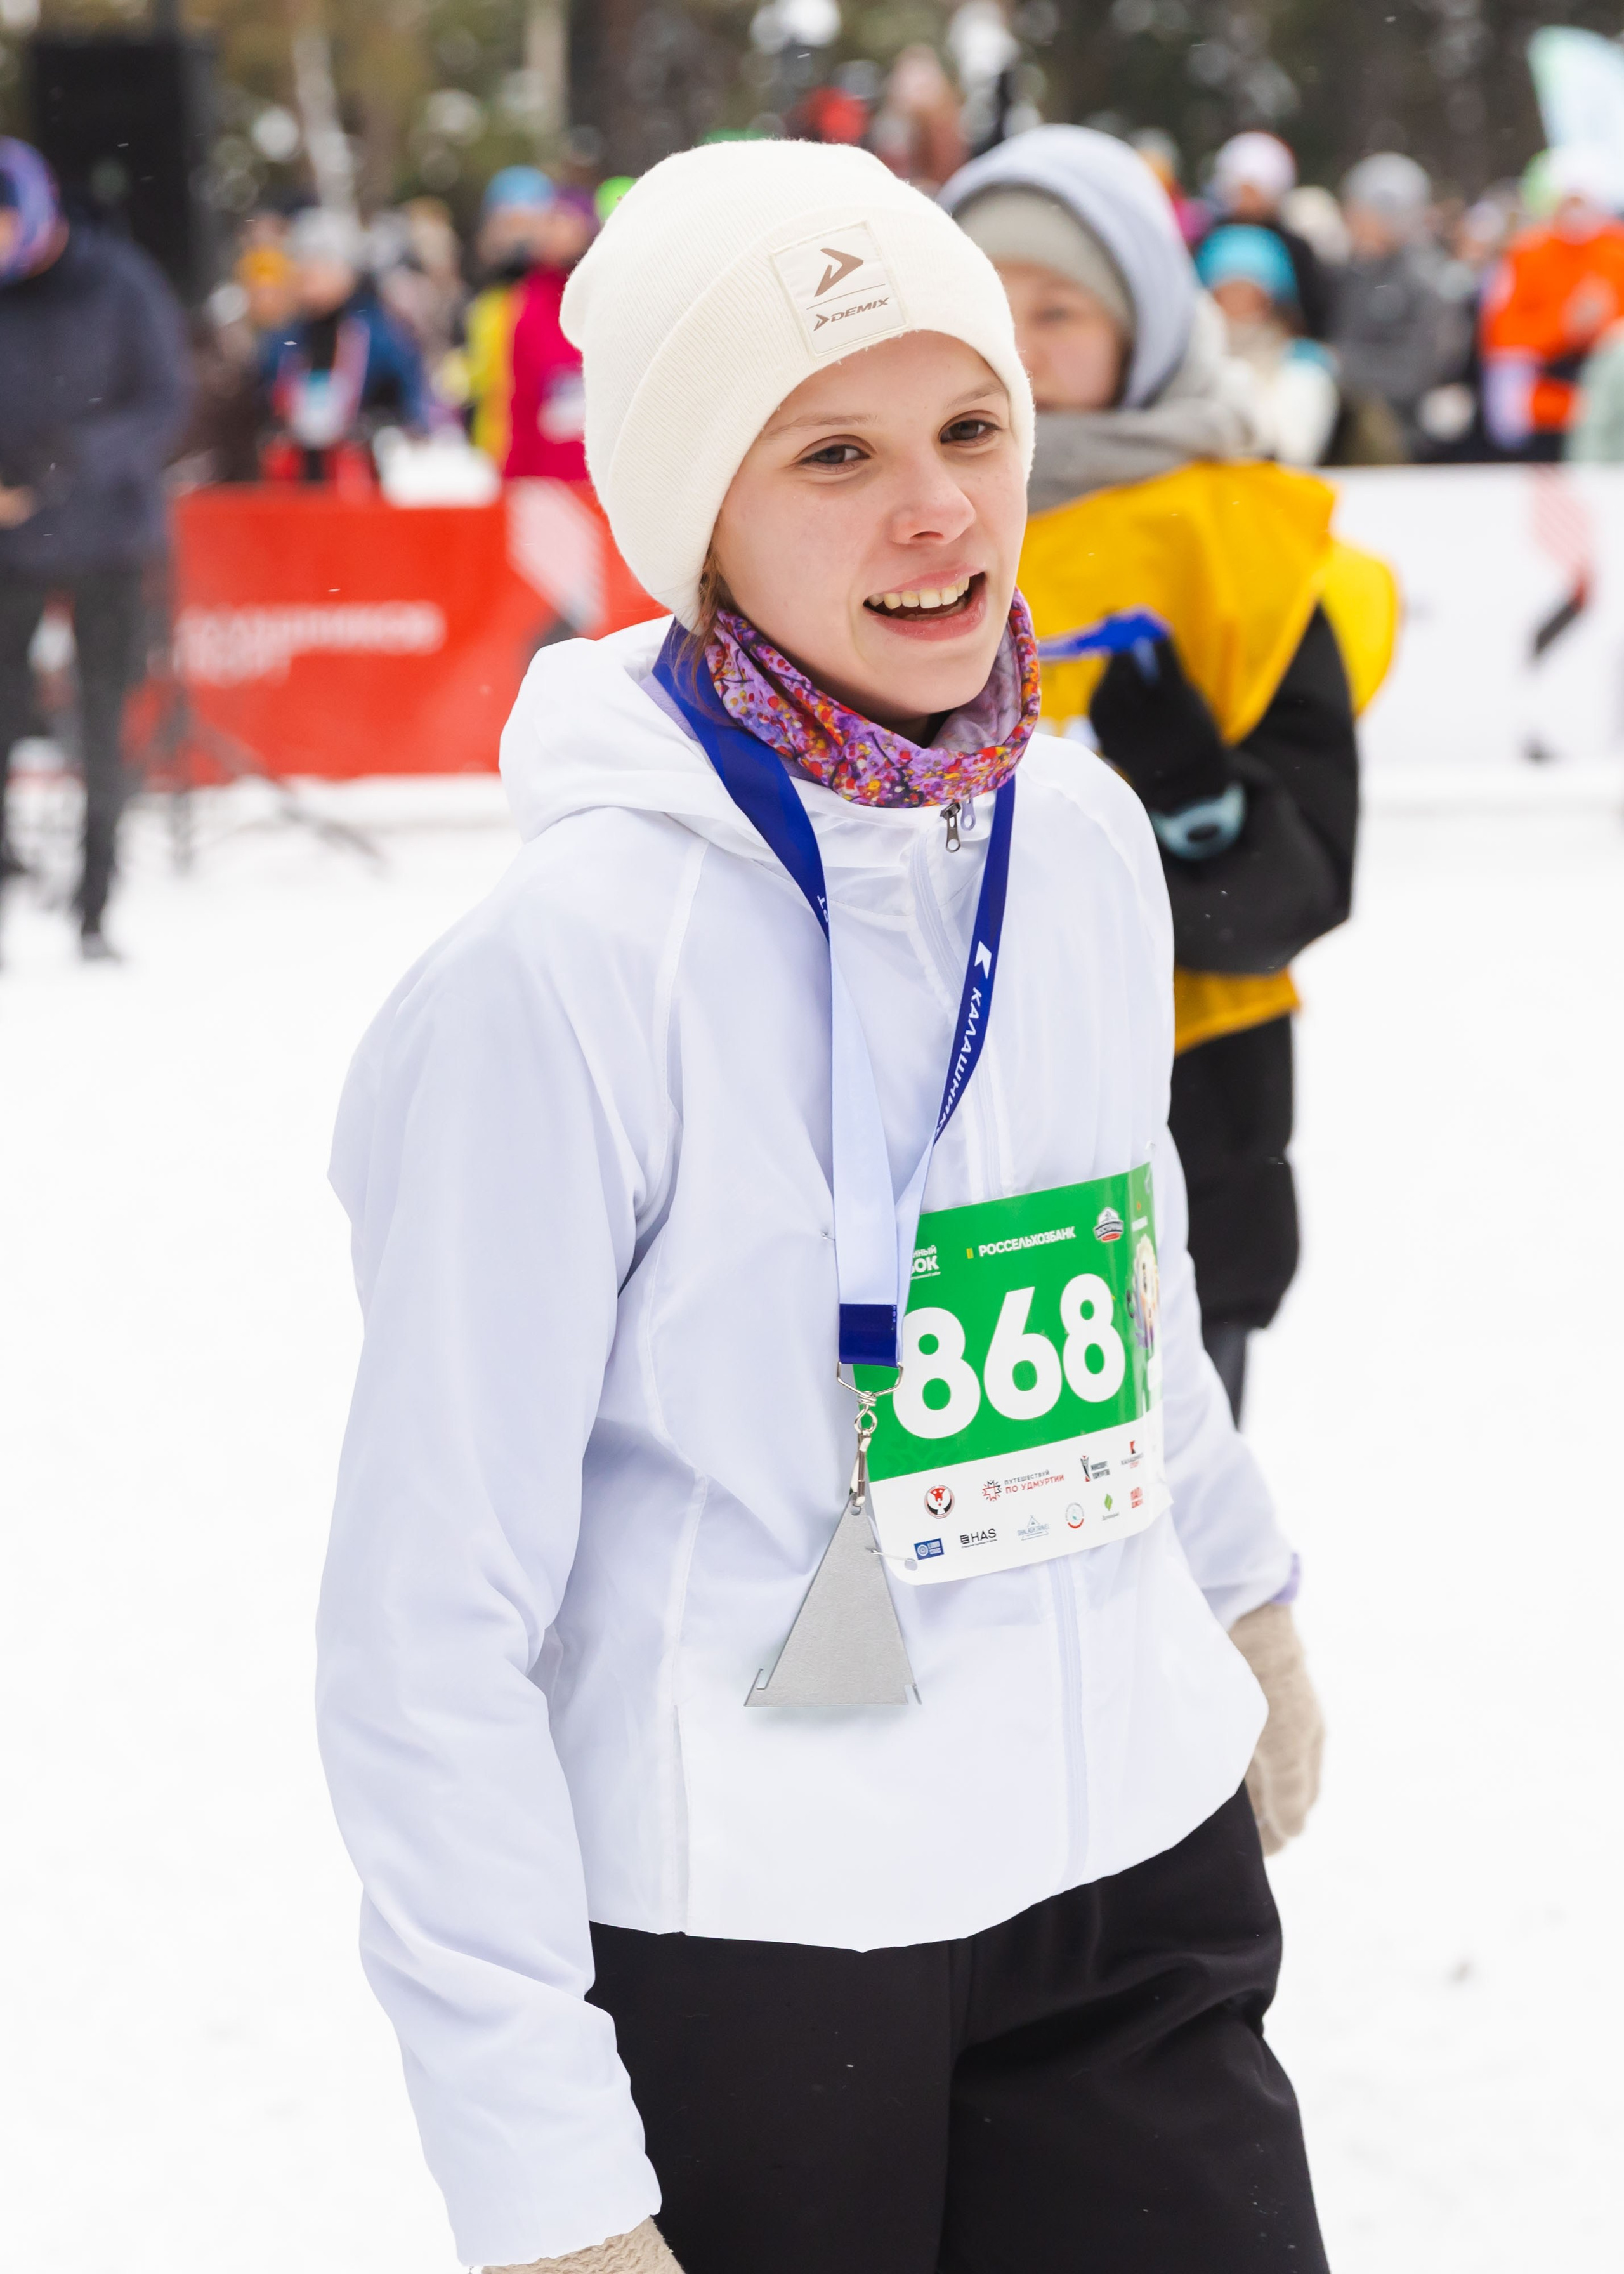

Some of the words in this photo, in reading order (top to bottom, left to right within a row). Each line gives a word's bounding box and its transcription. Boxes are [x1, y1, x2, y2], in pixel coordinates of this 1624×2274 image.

[831, 297, 889, 322] DEMIX
[978, 1226, 1077, 1257] РОССЕЛЬХОЗБАНК
[911, 1255, 940, 1274] ОК
[893, 1273, 1125, 1439] 868
[1004, 1469, 1050, 1485] ПУТЕШЕСТВУЙ
[1005, 1485, 1018, 1494] ПО
[1021, 1474, 1064, 1491] УДМУРТИИ
[971, 1528, 997, 1542] HAS
